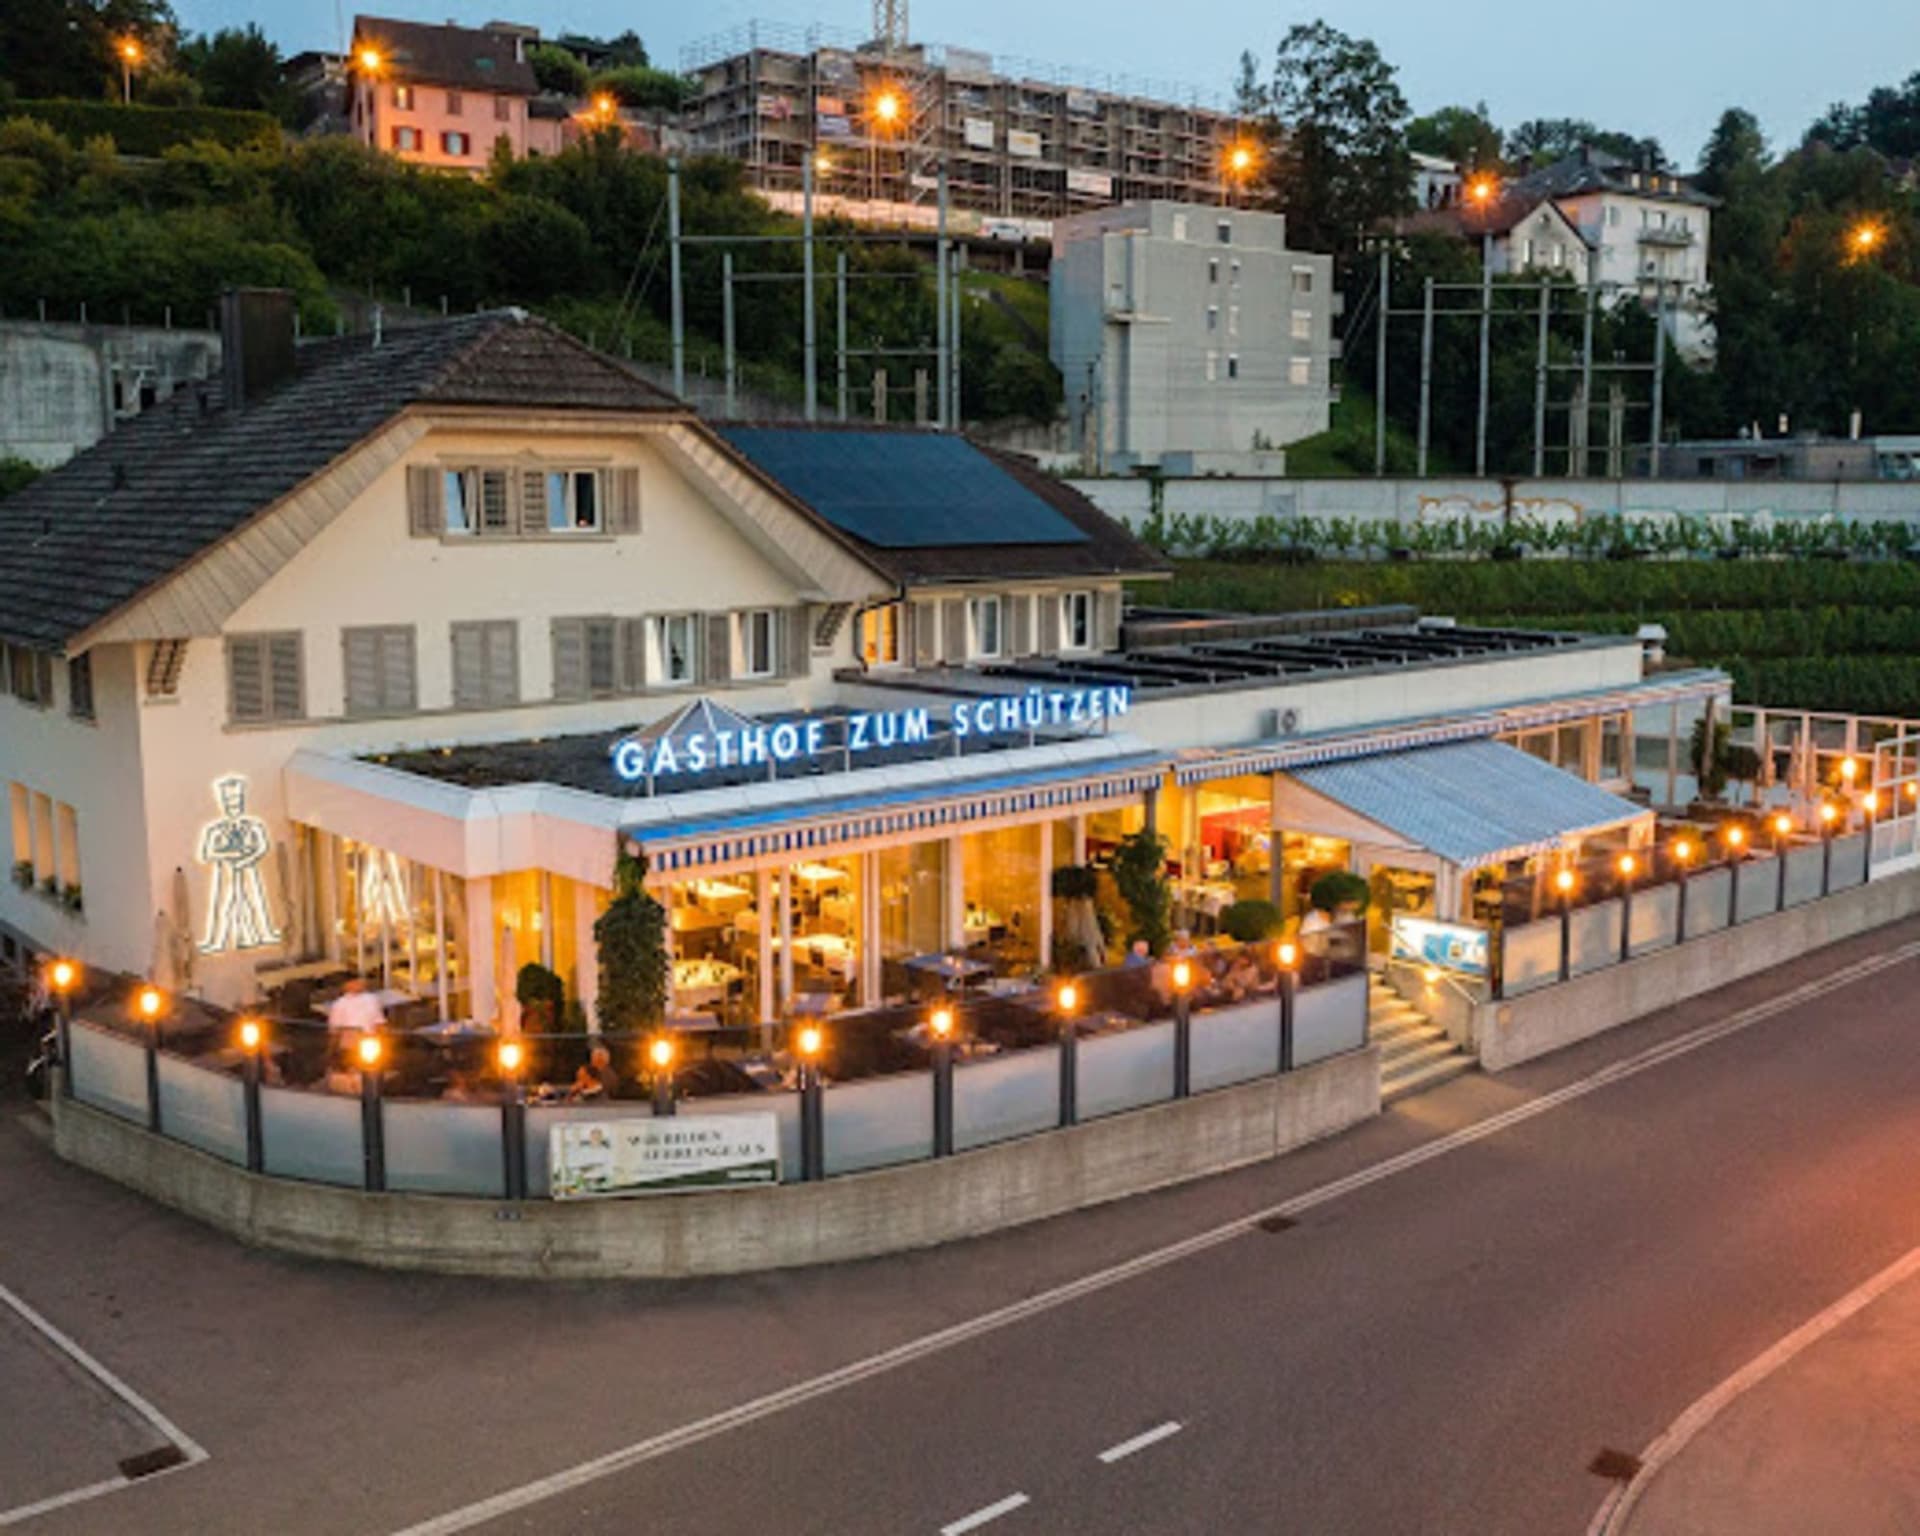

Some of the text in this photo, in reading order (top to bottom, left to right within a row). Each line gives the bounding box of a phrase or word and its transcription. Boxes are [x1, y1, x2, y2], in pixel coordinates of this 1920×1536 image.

[615, 686, 1130, 780] GASTHOF ZUM SCHÜTZEN
